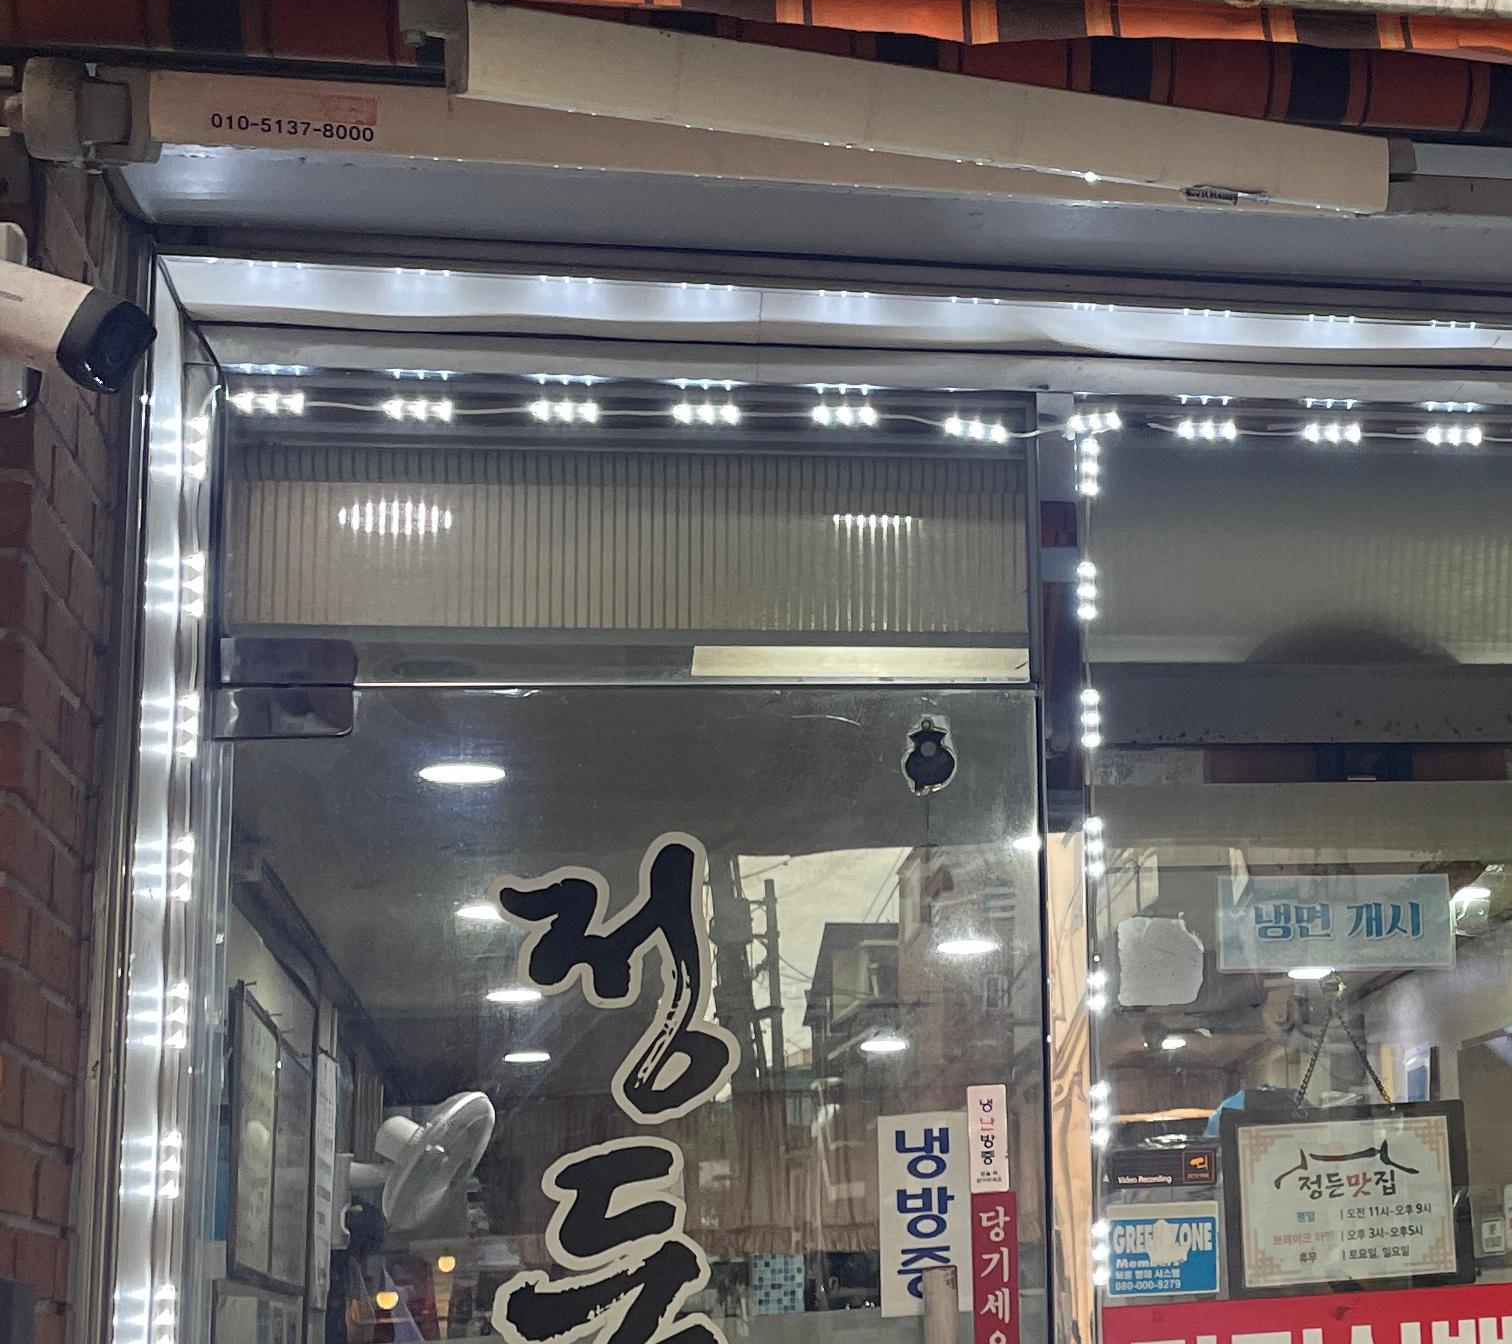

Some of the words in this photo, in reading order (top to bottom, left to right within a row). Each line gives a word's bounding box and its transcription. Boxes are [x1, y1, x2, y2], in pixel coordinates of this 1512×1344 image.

[211, 113, 374, 142] 010-5137-8000
[1252, 902, 1332, 940] 냉면
[1346, 901, 1423, 939] 개시
[1298, 1170, 1397, 1200] 정든맛집
[1346, 1208, 1366, 1219] 오전
